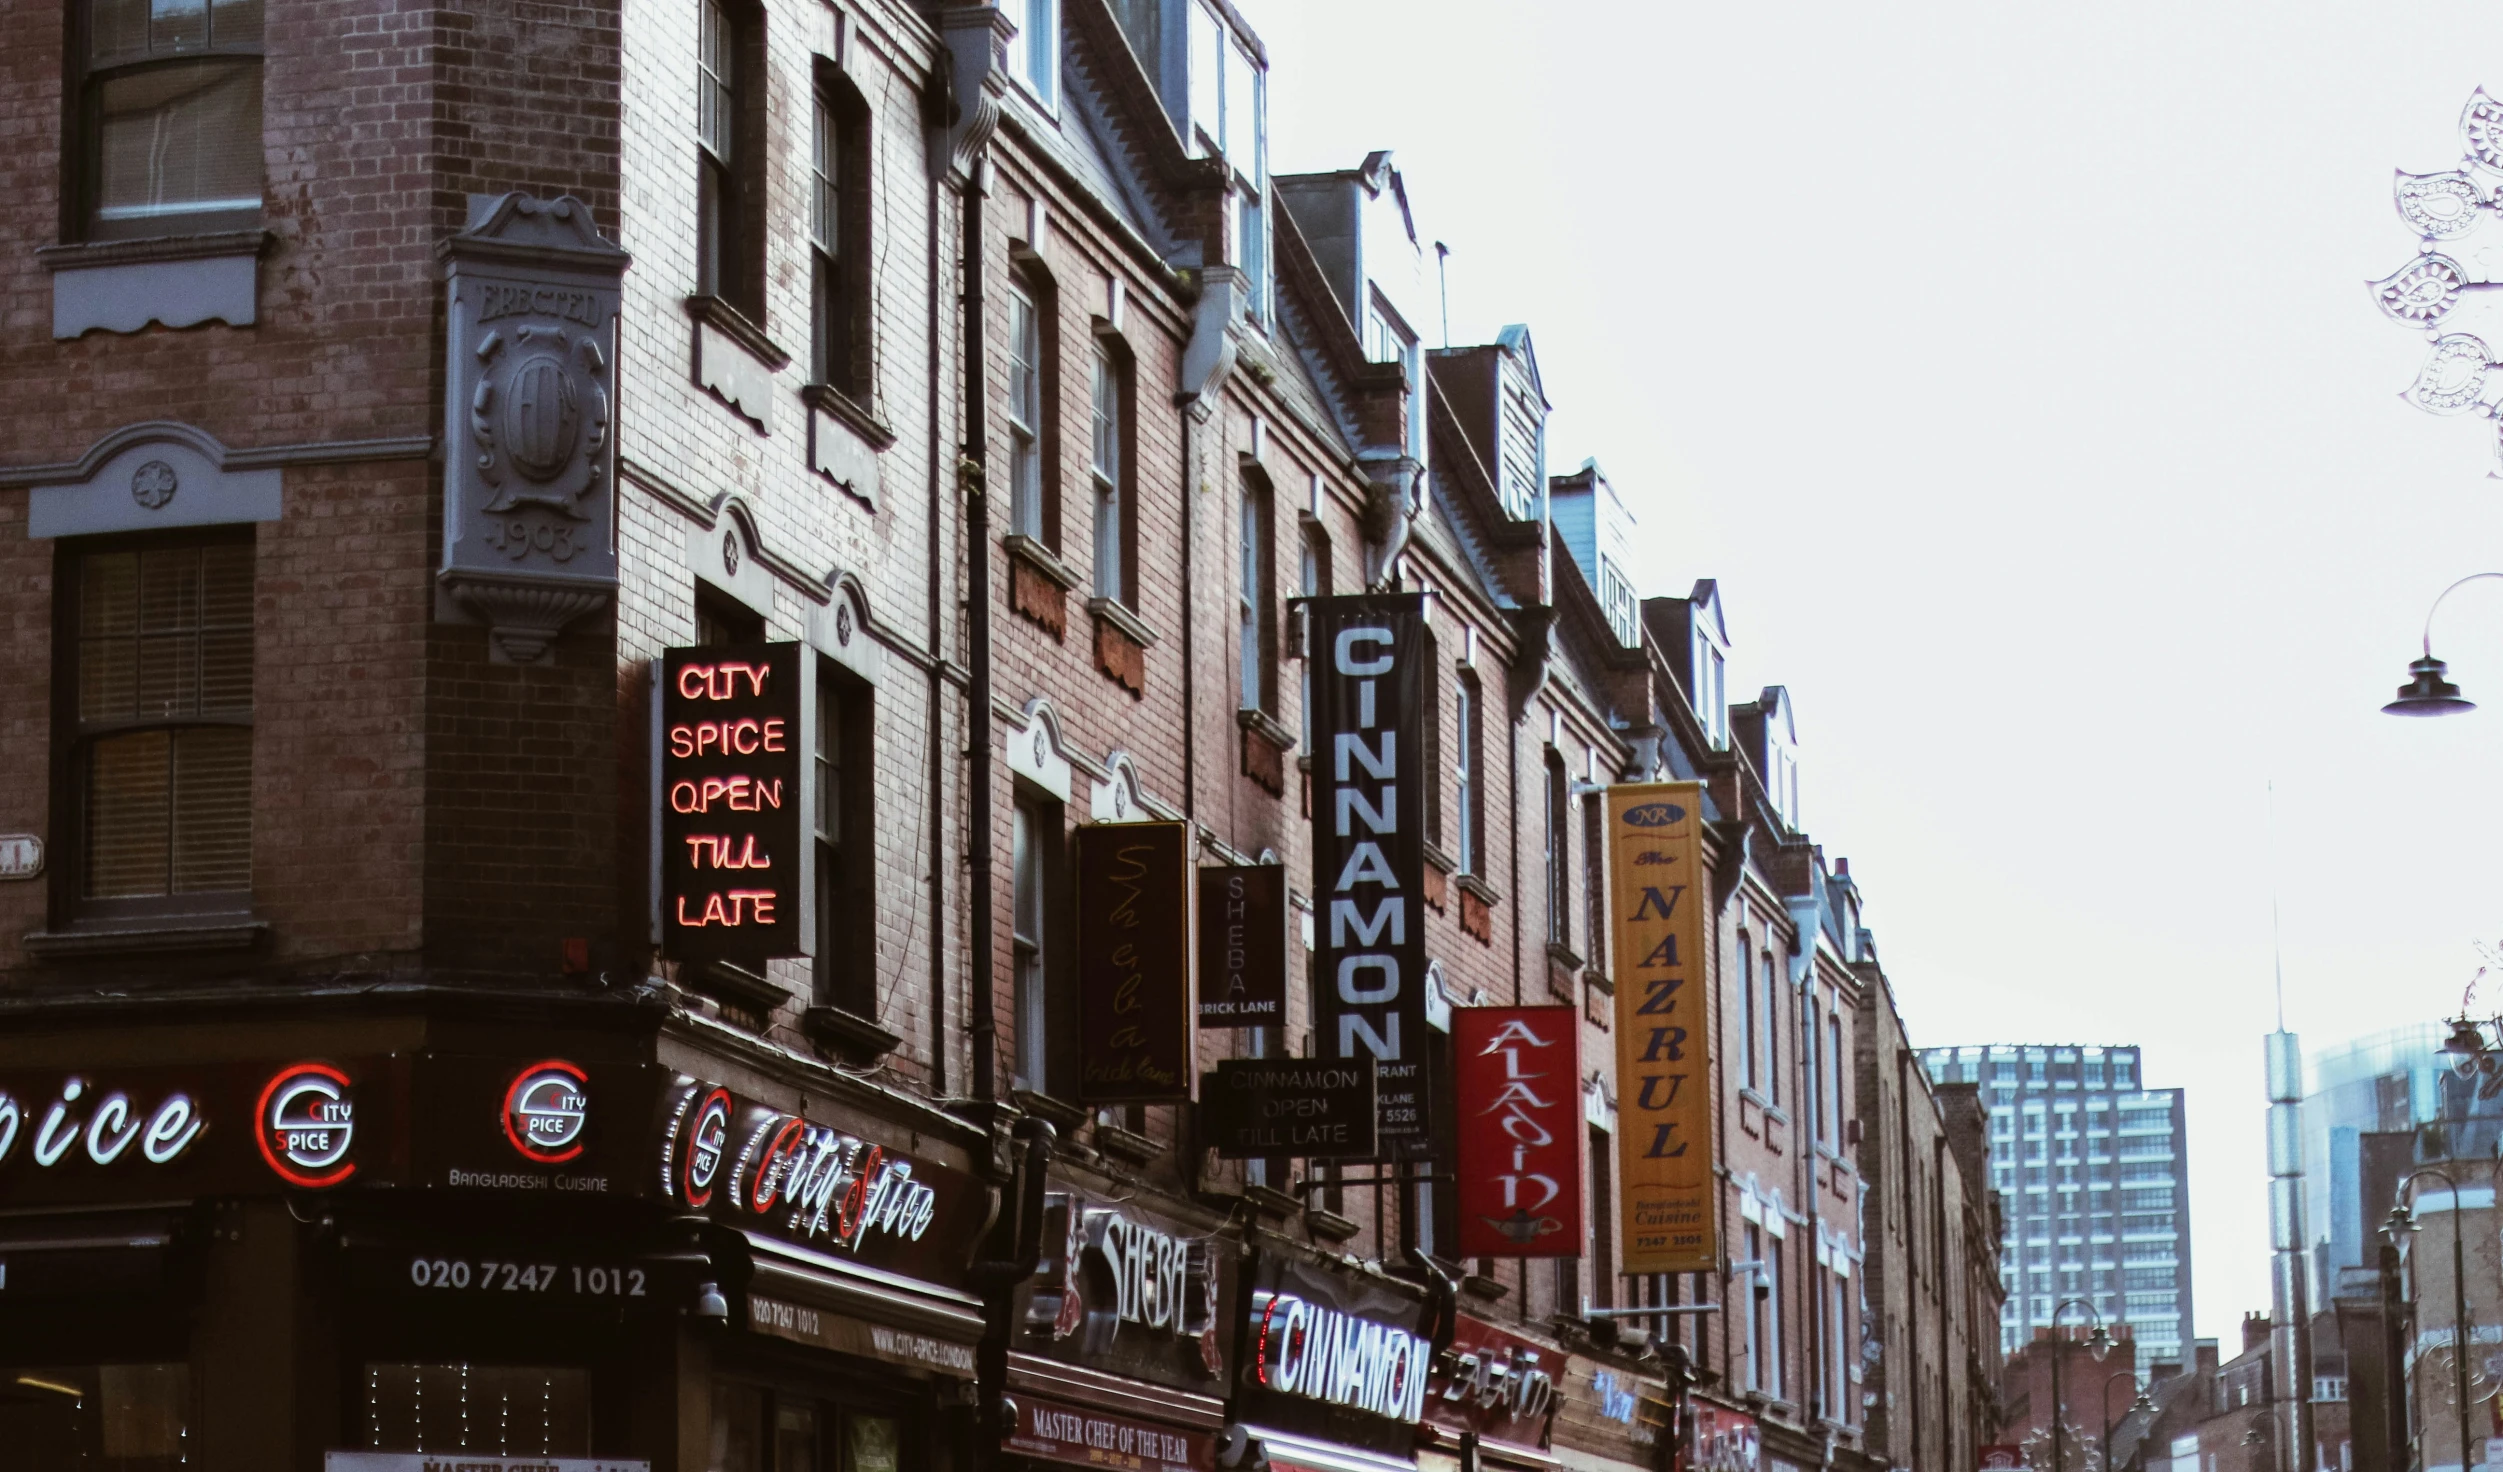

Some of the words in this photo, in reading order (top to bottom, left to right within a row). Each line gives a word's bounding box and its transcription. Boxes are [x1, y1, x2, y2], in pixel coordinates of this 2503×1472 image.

[477, 284, 602, 328] ERECTED
[679, 664, 771, 701] CITY
[670, 718, 786, 758] SPICE
[670, 777, 782, 814] OPEN
[685, 834, 771, 869] TILL
[1331, 627, 1406, 1061] CINNAMON
[677, 892, 777, 927] LATE
[1226, 876, 1247, 993] SHEBA
[1240, 1001, 1276, 1013] LANE
[1627, 885, 1688, 1160] NAZRUL
[1231, 1069, 1358, 1089] CINNAMON
[1376, 1065, 1416, 1077] RANT
[309, 1101, 353, 1124] CITY
[550, 1092, 587, 1111] CITY
[1262, 1098, 1328, 1117] OPEN
[1386, 1109, 1416, 1122] 5526
[276, 1130, 329, 1151] SPICE
[518, 1113, 564, 1133] SPICE
[1239, 1127, 1282, 1146] TILL
[1292, 1123, 1348, 1145] LATE
[752, 1118, 842, 1238] City
[840, 1145, 935, 1253] Spice
[1635, 1210, 1701, 1225] Cuisine
[411, 1260, 471, 1288] 020
[480, 1262, 558, 1292] 7247
[572, 1267, 646, 1296] 1012
[1102, 1212, 1188, 1344] SHEBA
[753, 1298, 771, 1323] 020
[771, 1303, 794, 1329] 7247
[797, 1309, 819, 1335] 1012
[1279, 1299, 1431, 1424] CINNAMON
[1032, 1406, 1082, 1445] MASTER
[1085, 1419, 1116, 1450] CHEF
[1118, 1425, 1135, 1454] OF
[1136, 1429, 1158, 1459] THE
[1161, 1434, 1188, 1464] YEAR
